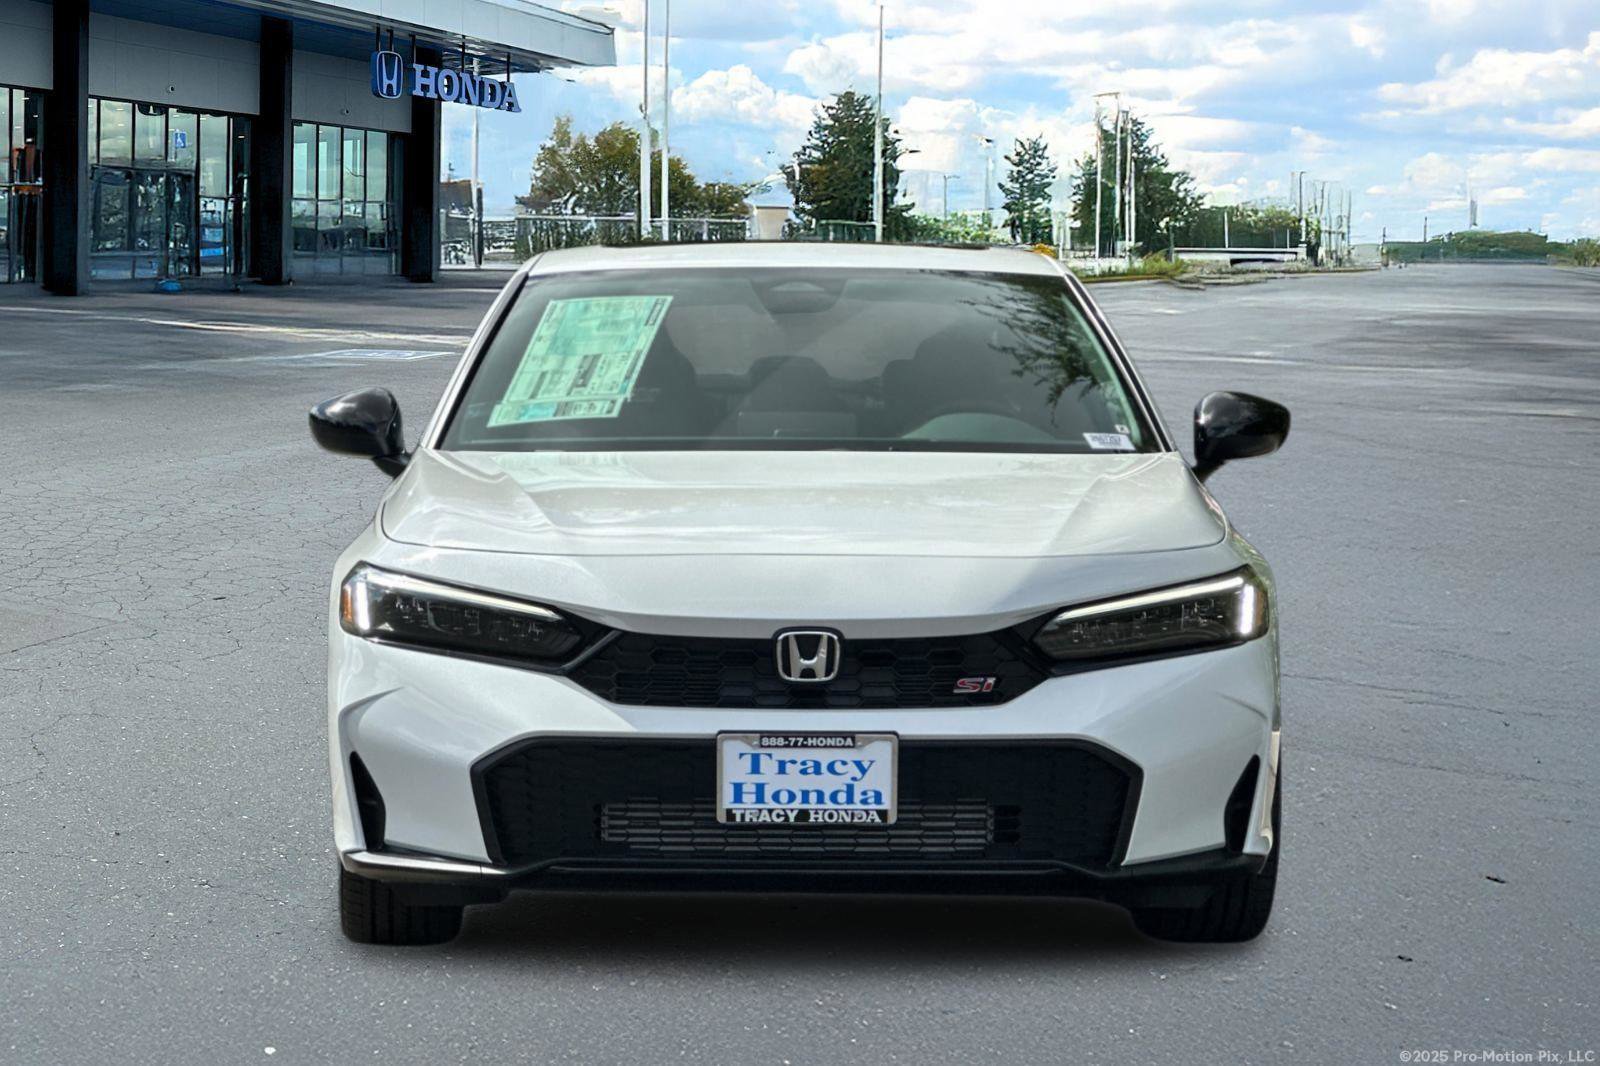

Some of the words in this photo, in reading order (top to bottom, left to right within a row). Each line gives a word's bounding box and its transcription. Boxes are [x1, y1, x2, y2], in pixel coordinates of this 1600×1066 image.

[412, 63, 522, 113] HONDA
[761, 736, 854, 747] 888-77-HONDA
[739, 752, 876, 782] Tracy
[729, 782, 885, 806] Honda
[732, 809, 800, 823] TRACY
[809, 810, 882, 823] HONDA
